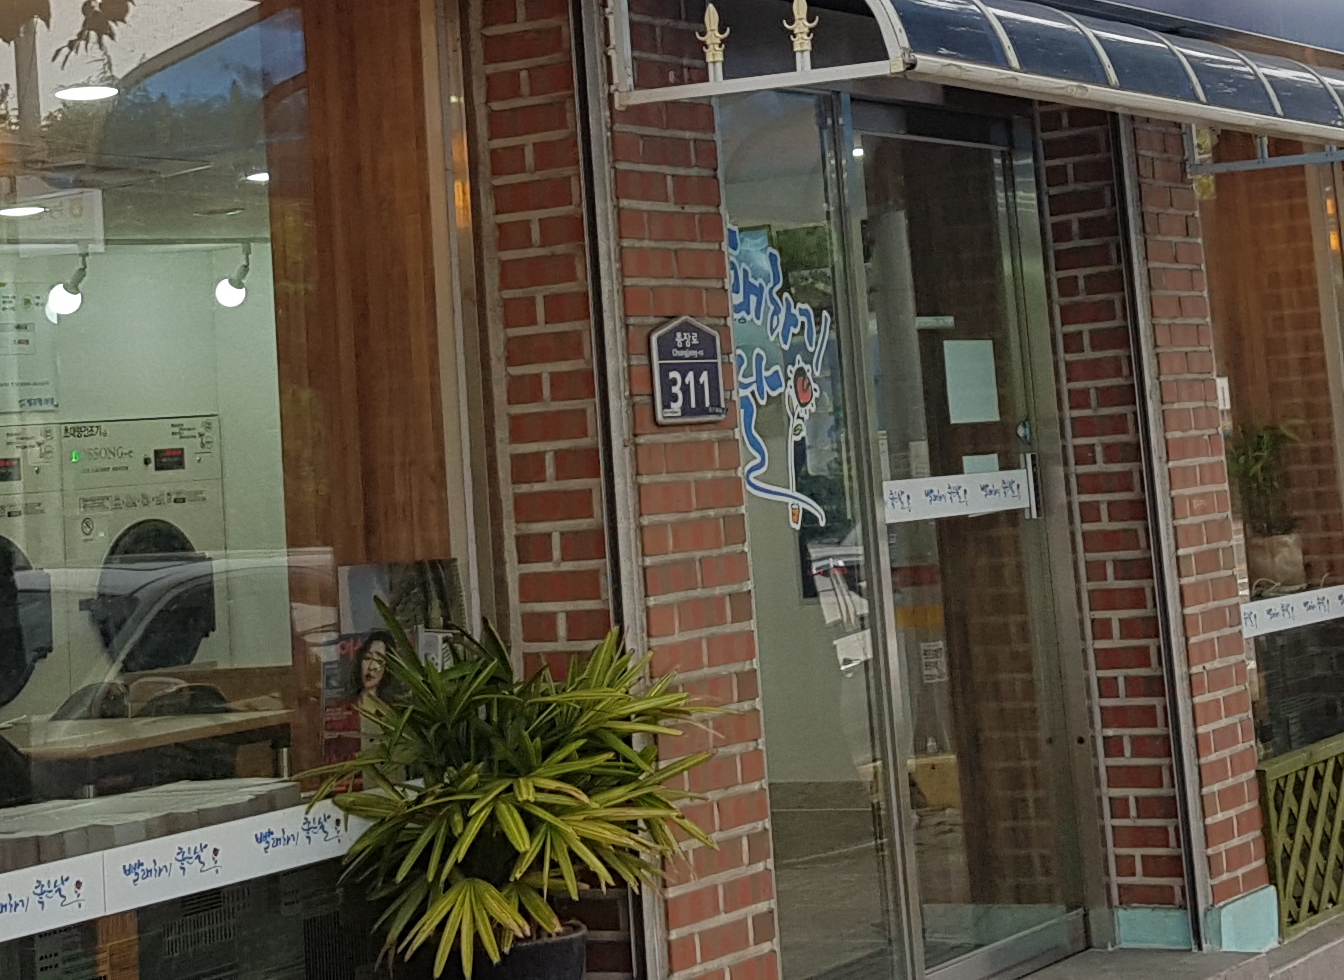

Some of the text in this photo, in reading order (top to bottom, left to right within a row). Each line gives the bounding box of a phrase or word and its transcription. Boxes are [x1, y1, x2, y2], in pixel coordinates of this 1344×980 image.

[728, 225, 831, 377] 래하기
[668, 370, 710, 409] 311
[123, 858, 172, 886] 빨래하기
